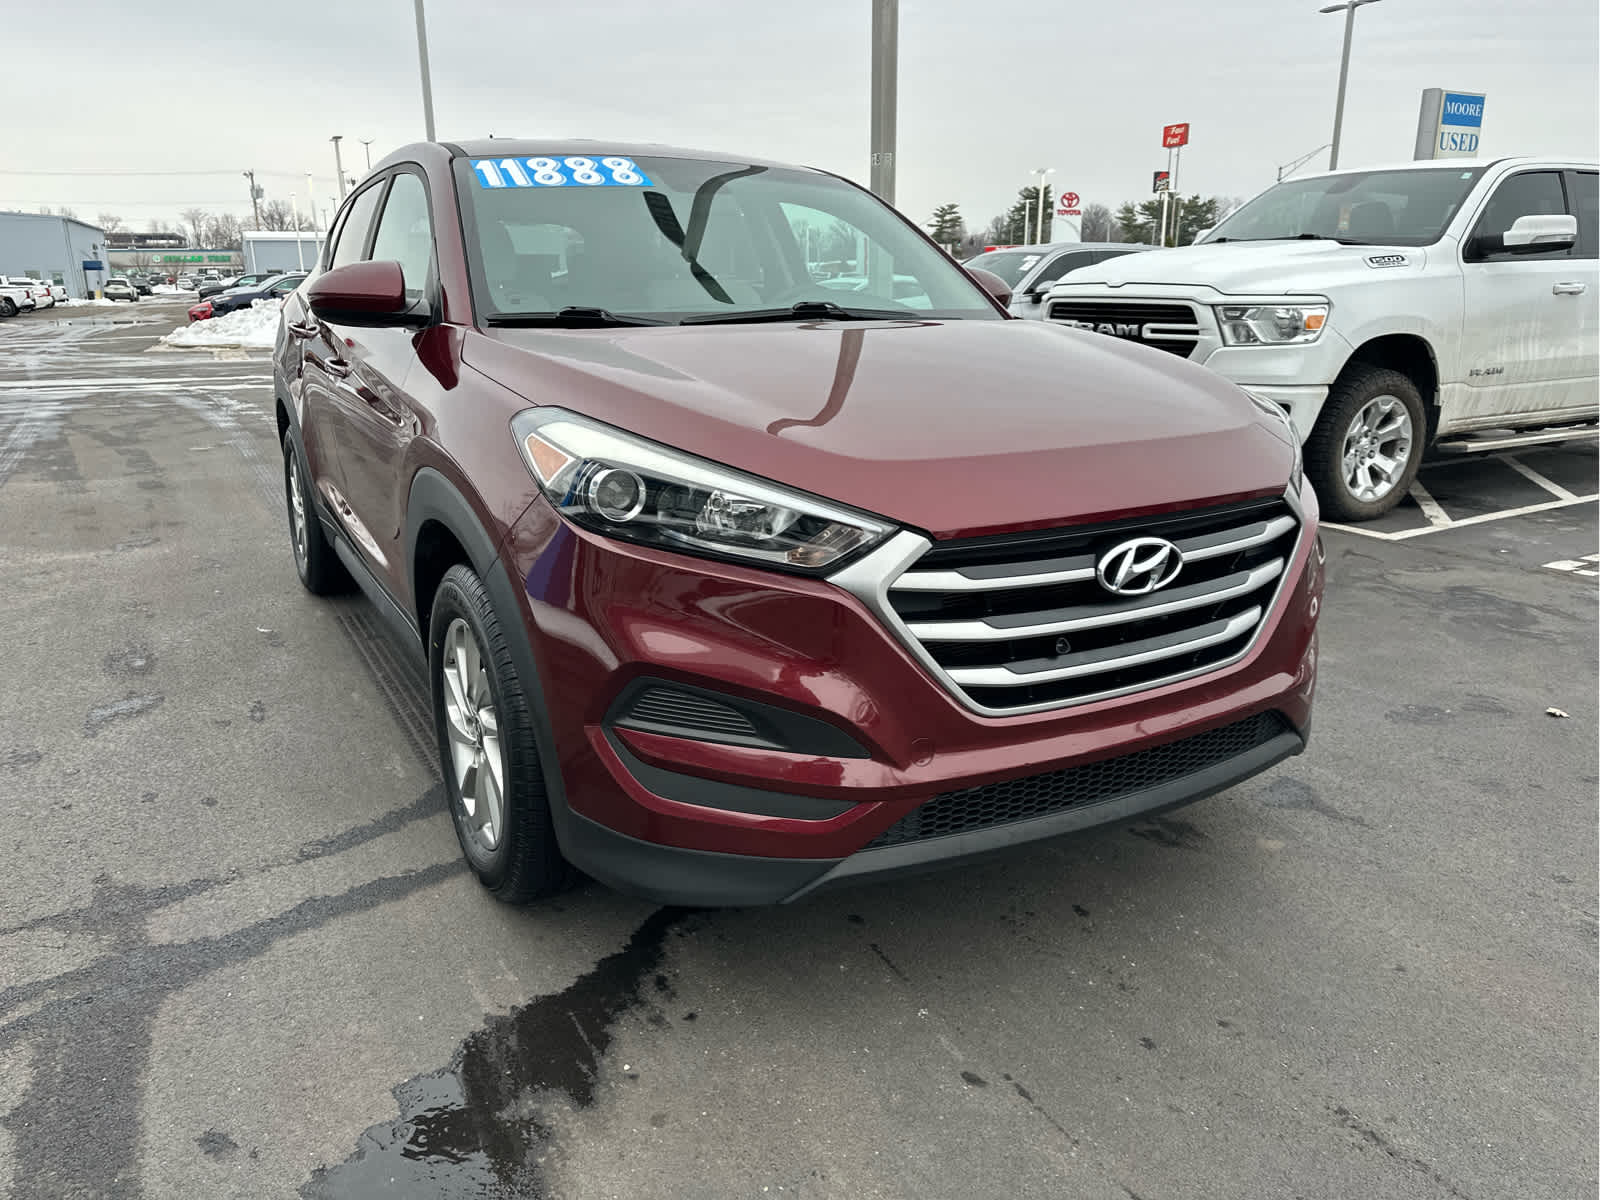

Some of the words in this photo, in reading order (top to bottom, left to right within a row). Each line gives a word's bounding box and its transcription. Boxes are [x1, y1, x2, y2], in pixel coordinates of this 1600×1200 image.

[1446, 101, 1482, 117] MOORE
[1440, 131, 1479, 152] USED
[475, 157, 644, 187] 11888
